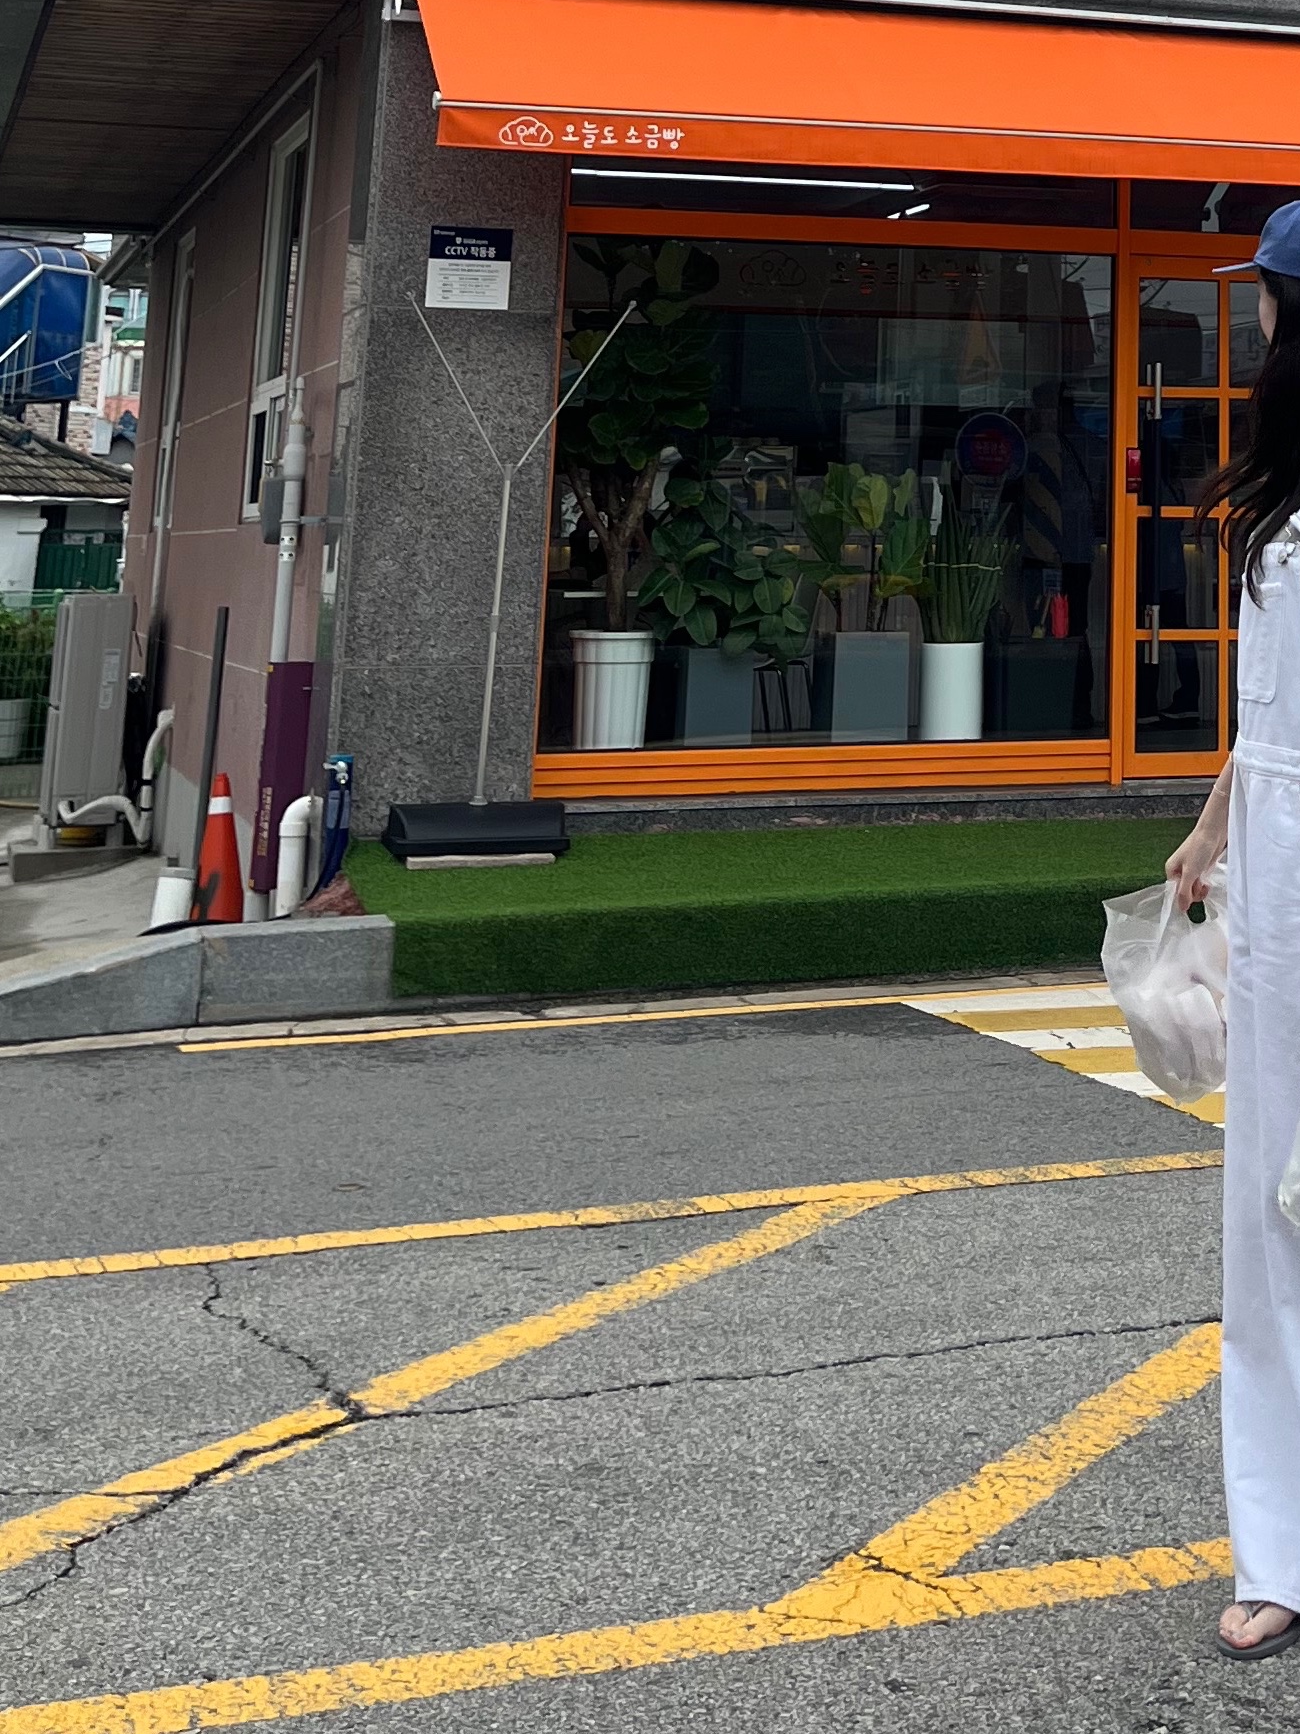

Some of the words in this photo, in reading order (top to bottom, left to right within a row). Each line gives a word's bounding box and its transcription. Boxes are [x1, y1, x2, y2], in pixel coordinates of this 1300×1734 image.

[561, 120, 618, 149] 오늘도
[624, 124, 686, 150] 소금빵
[444, 245, 468, 256] CCTV
